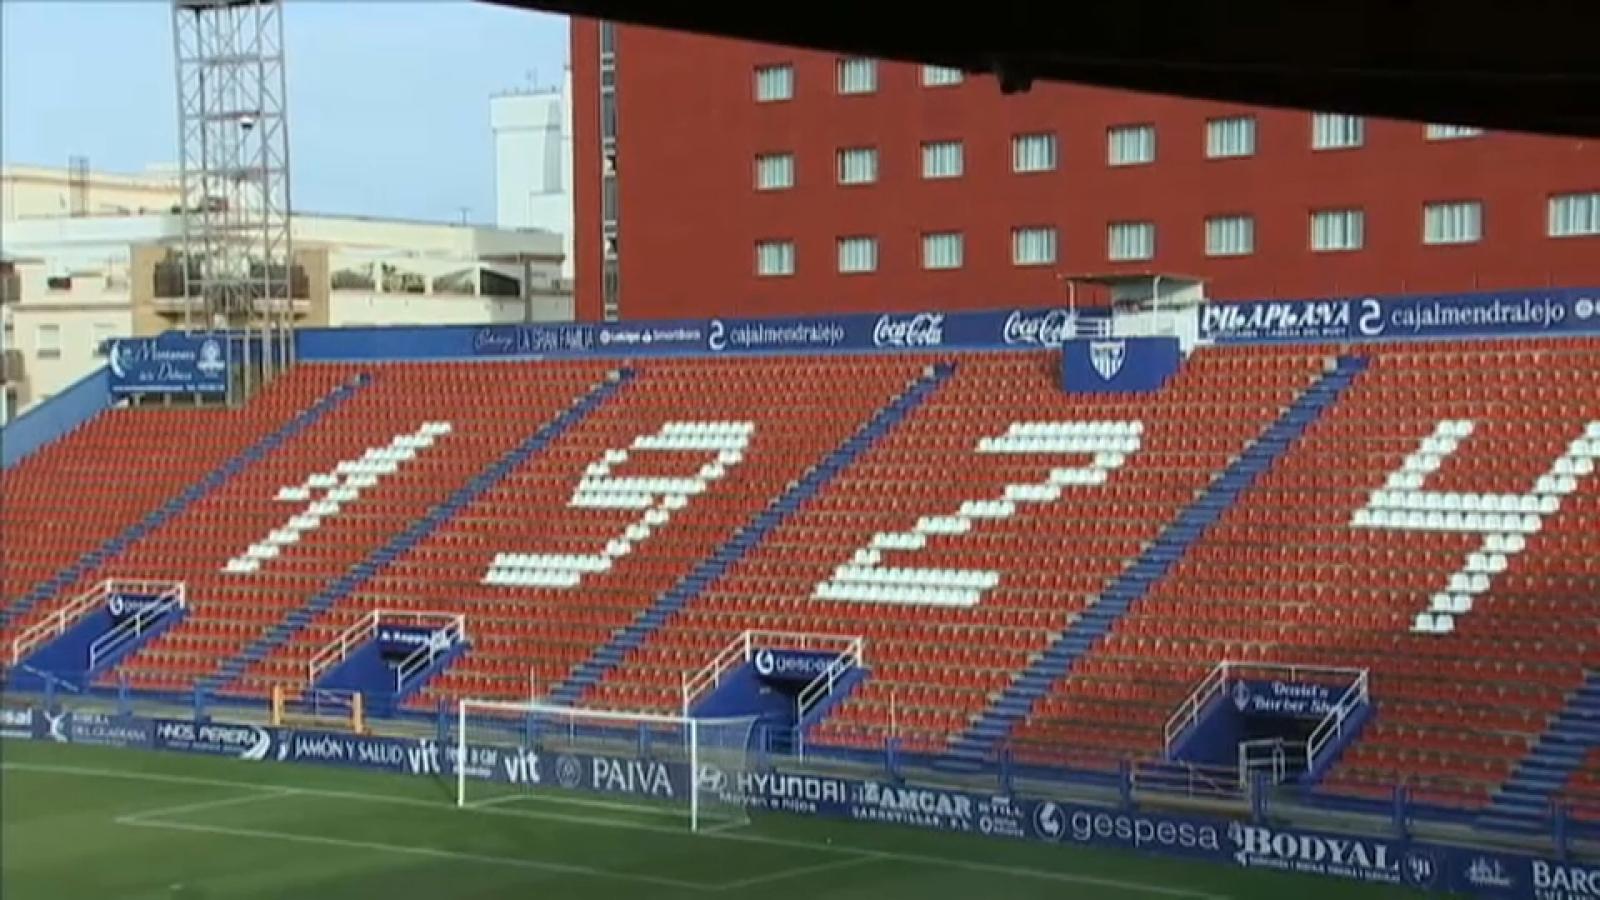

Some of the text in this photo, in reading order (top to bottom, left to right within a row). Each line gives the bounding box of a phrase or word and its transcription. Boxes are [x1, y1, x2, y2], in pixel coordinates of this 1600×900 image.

[1391, 299, 1565, 333] cajalmendralejo
[729, 322, 845, 352] cajalmendralejo
[295, 734, 402, 765] JAMÓN Y SALUD
[408, 737, 440, 774] vit
[504, 747, 540, 783] vit
[592, 757, 673, 796] PAIVA
[736, 772, 846, 804] HYUNDAI
[1071, 810, 1221, 850] gespesa
[1244, 825, 1400, 871] BODYAL
